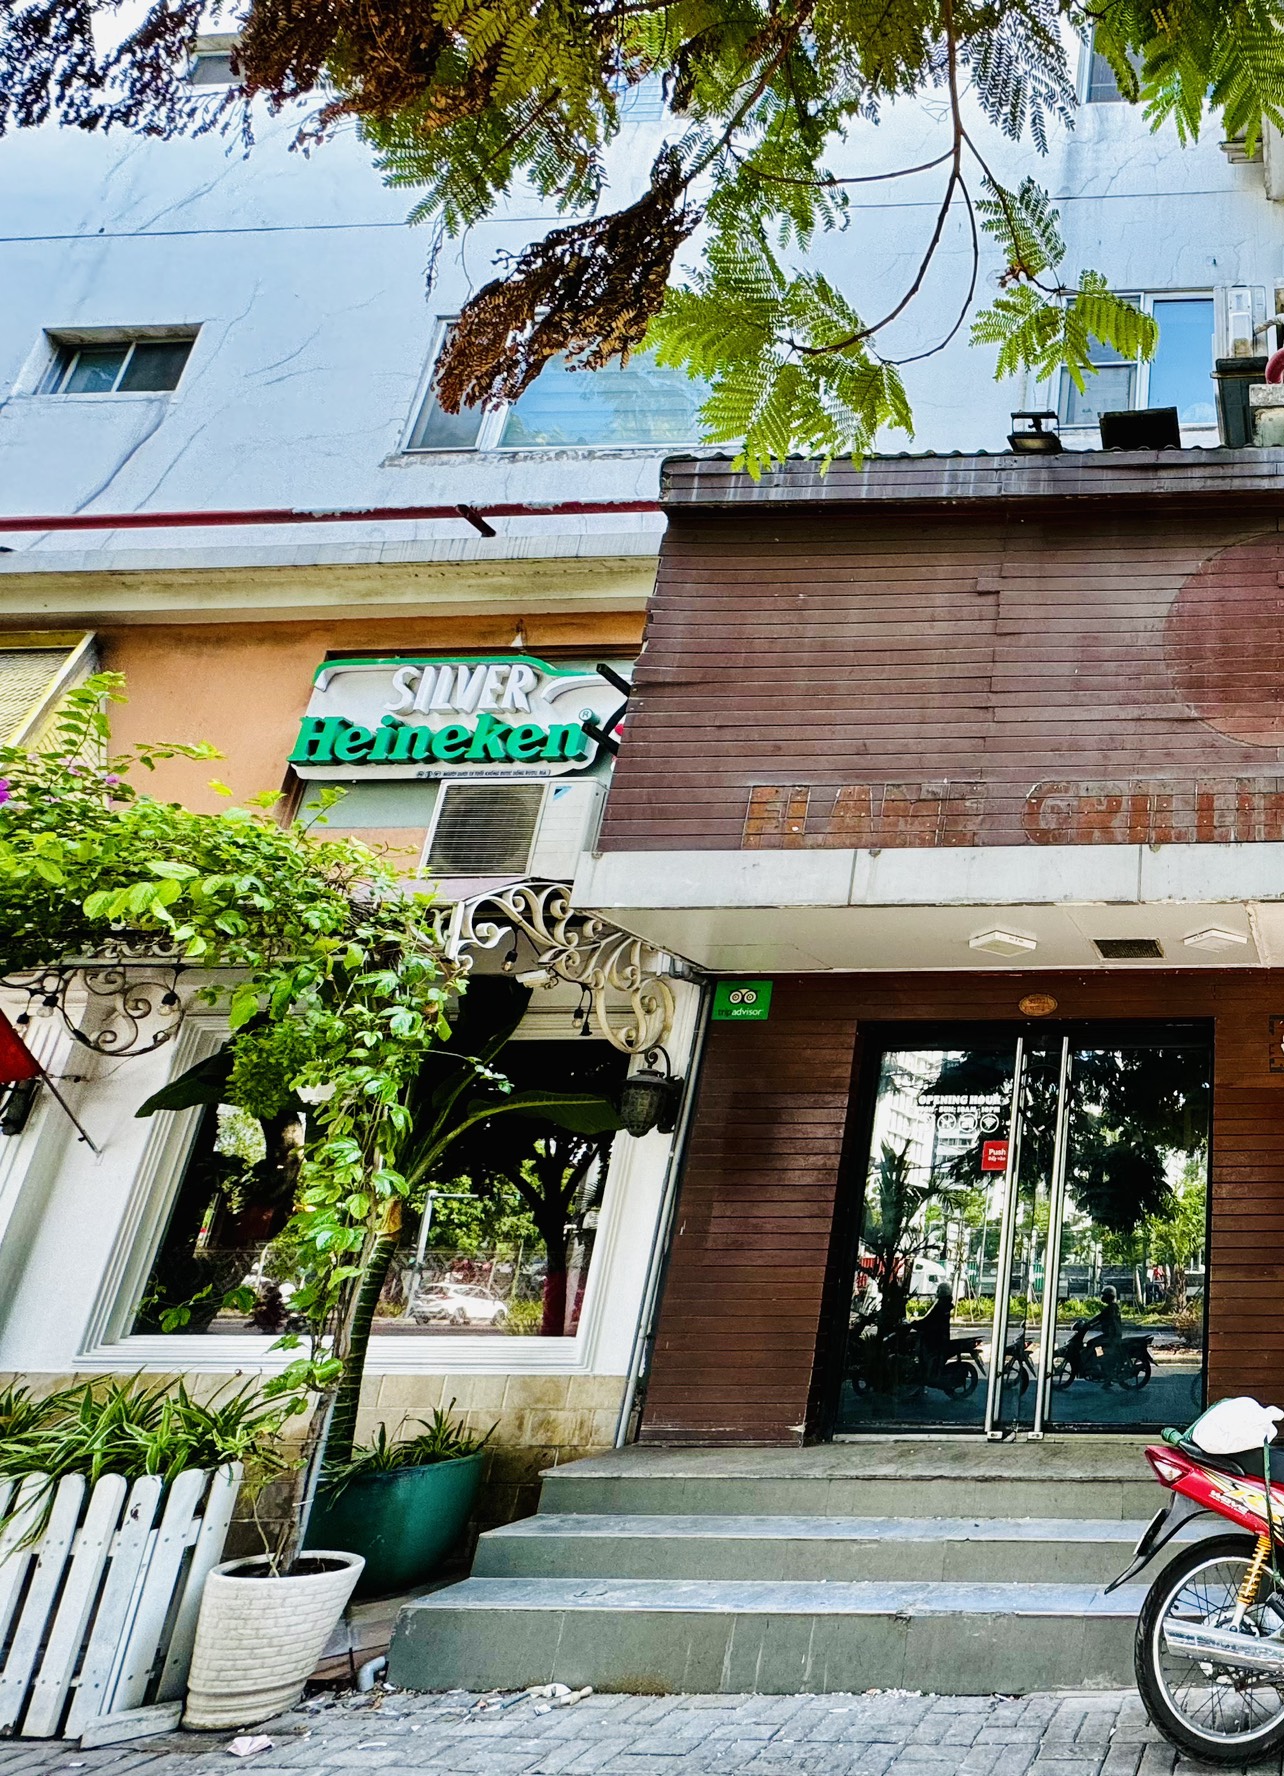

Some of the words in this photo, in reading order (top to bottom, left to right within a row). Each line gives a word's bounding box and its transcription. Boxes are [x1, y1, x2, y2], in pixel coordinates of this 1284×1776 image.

[384, 663, 538, 715] SILVER
[287, 713, 588, 766] Heineken
[918, 1094, 968, 1105] OPENING
[988, 1148, 1007, 1156] Push
